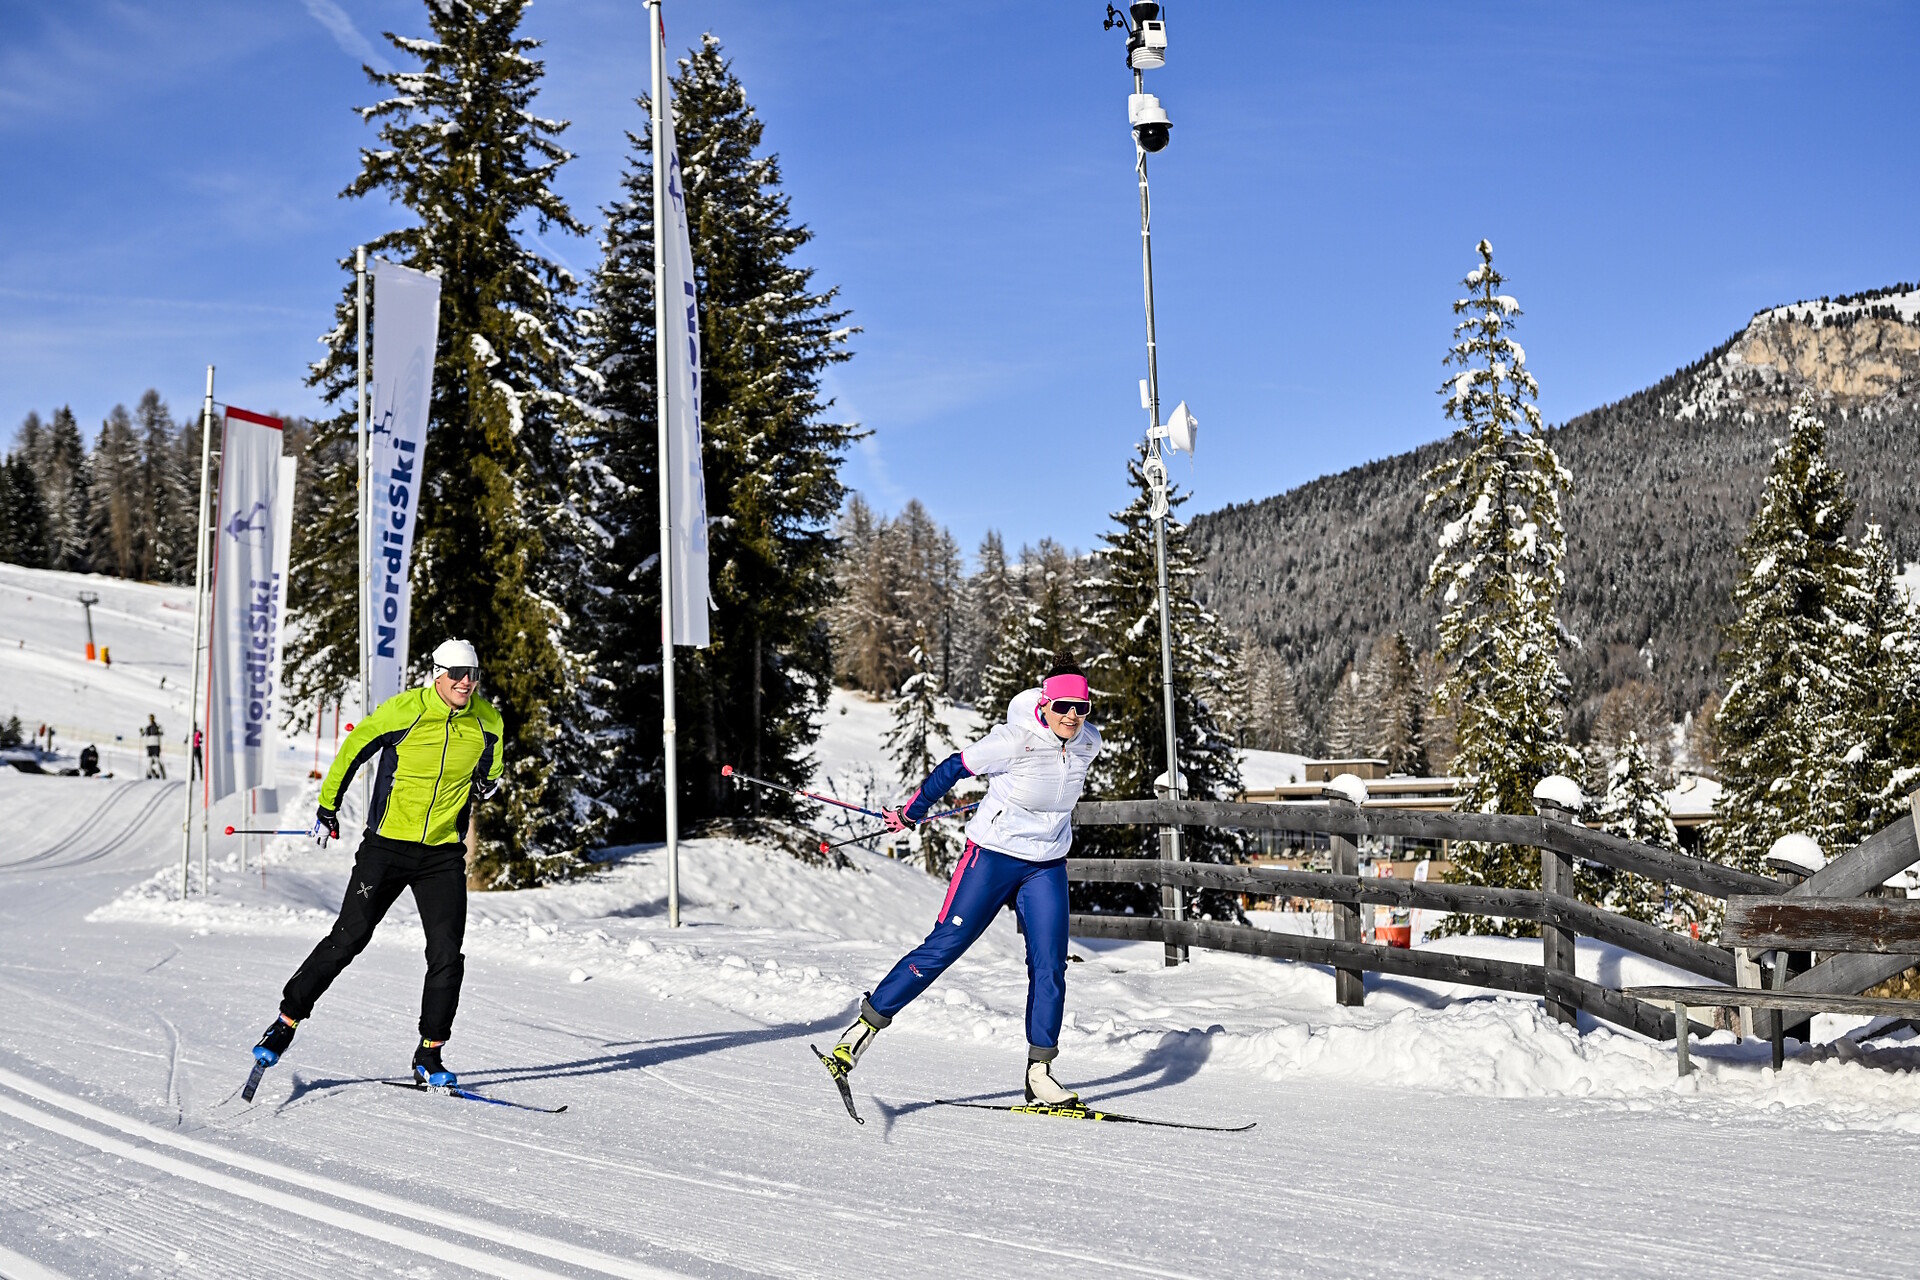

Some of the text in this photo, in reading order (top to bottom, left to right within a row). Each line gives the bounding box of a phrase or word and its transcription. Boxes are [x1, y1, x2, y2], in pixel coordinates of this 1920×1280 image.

[377, 437, 416, 659] NordicSki
[245, 579, 270, 748] NordicSki
[1010, 1106, 1086, 1120] FISCHER
